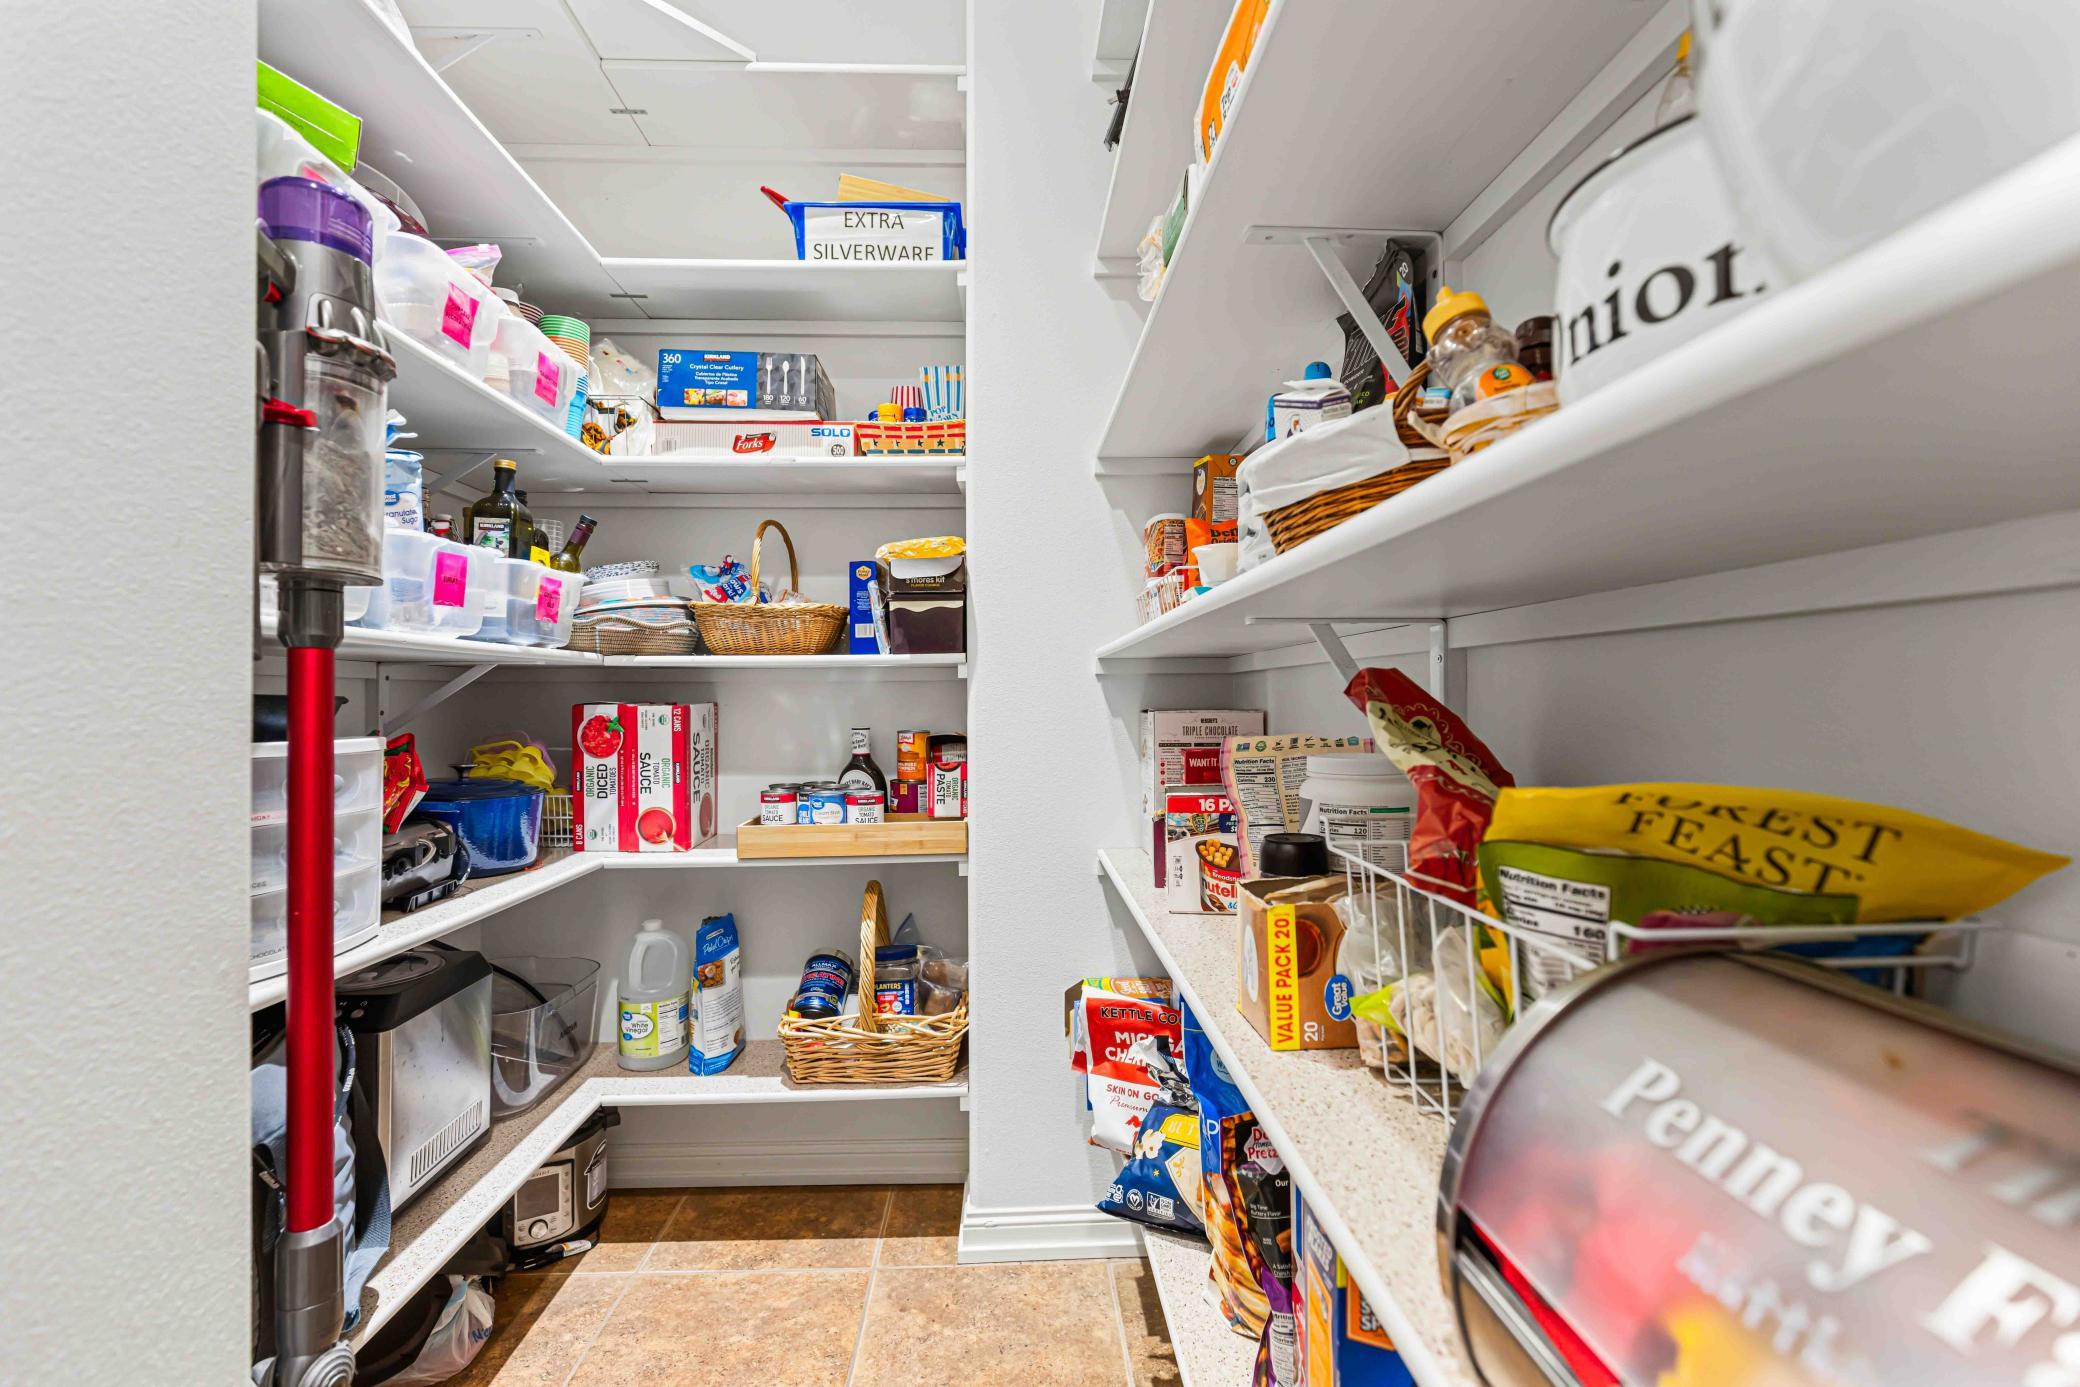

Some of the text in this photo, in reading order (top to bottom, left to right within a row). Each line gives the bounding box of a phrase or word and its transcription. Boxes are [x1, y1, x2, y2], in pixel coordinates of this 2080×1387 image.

[844, 211, 905, 230] EXTRA
[1400, 261, 1409, 278] 20
[662, 353, 682, 364] 360
[811, 428, 851, 438] SOLO
[735, 437, 764, 451] Forks
[832, 447, 844, 456] 500
[384, 509, 418, 518] ranulate
[935, 576, 946, 584] kit
[674, 708, 682, 732] 12 CANS
[1182, 725, 1239, 736] TRIPLE CHOCOLATE
[692, 732, 701, 804] SAUCE
[1188, 758, 1210, 768] WANT
[640, 752, 652, 794] SAUCE
[661, 758, 670, 788] ORGANIC
[586, 766, 595, 798] ORGANIC
[596, 764, 608, 799] DICED
[609, 768, 617, 796] TOMATOES
[936, 774, 946, 805] PASTE
[1198, 798, 1216, 812] 16
[1320, 807, 1348, 815] Nutrition
[762, 814, 783, 822] SAUCE
[576, 824, 584, 840] CANS
[1628, 808, 1859, 894] FEAST
[1500, 868, 1606, 899] Nutrition Facts
[1573, 926, 1606, 940] 160
[811, 962, 837, 970] ALLMAX
[1274, 944, 1292, 988] PACK
[876, 982, 902, 990] LANTERS
[1340, 977, 1348, 1008] Value
[1332, 982, 1342, 1016] Great
[1101, 1006, 1154, 1022] KETTLE
[1276, 993, 1294, 1044] VALUE
[1304, 1021, 1318, 1042] 20
[1106, 1084, 1126, 1096] SKIN
[1127, 1090, 1140, 1098] ON
[1248, 1147, 1280, 1160] Pretz
[1275, 1178, 1289, 1188] Our
[1602, 1057, 1933, 1293] Penney
